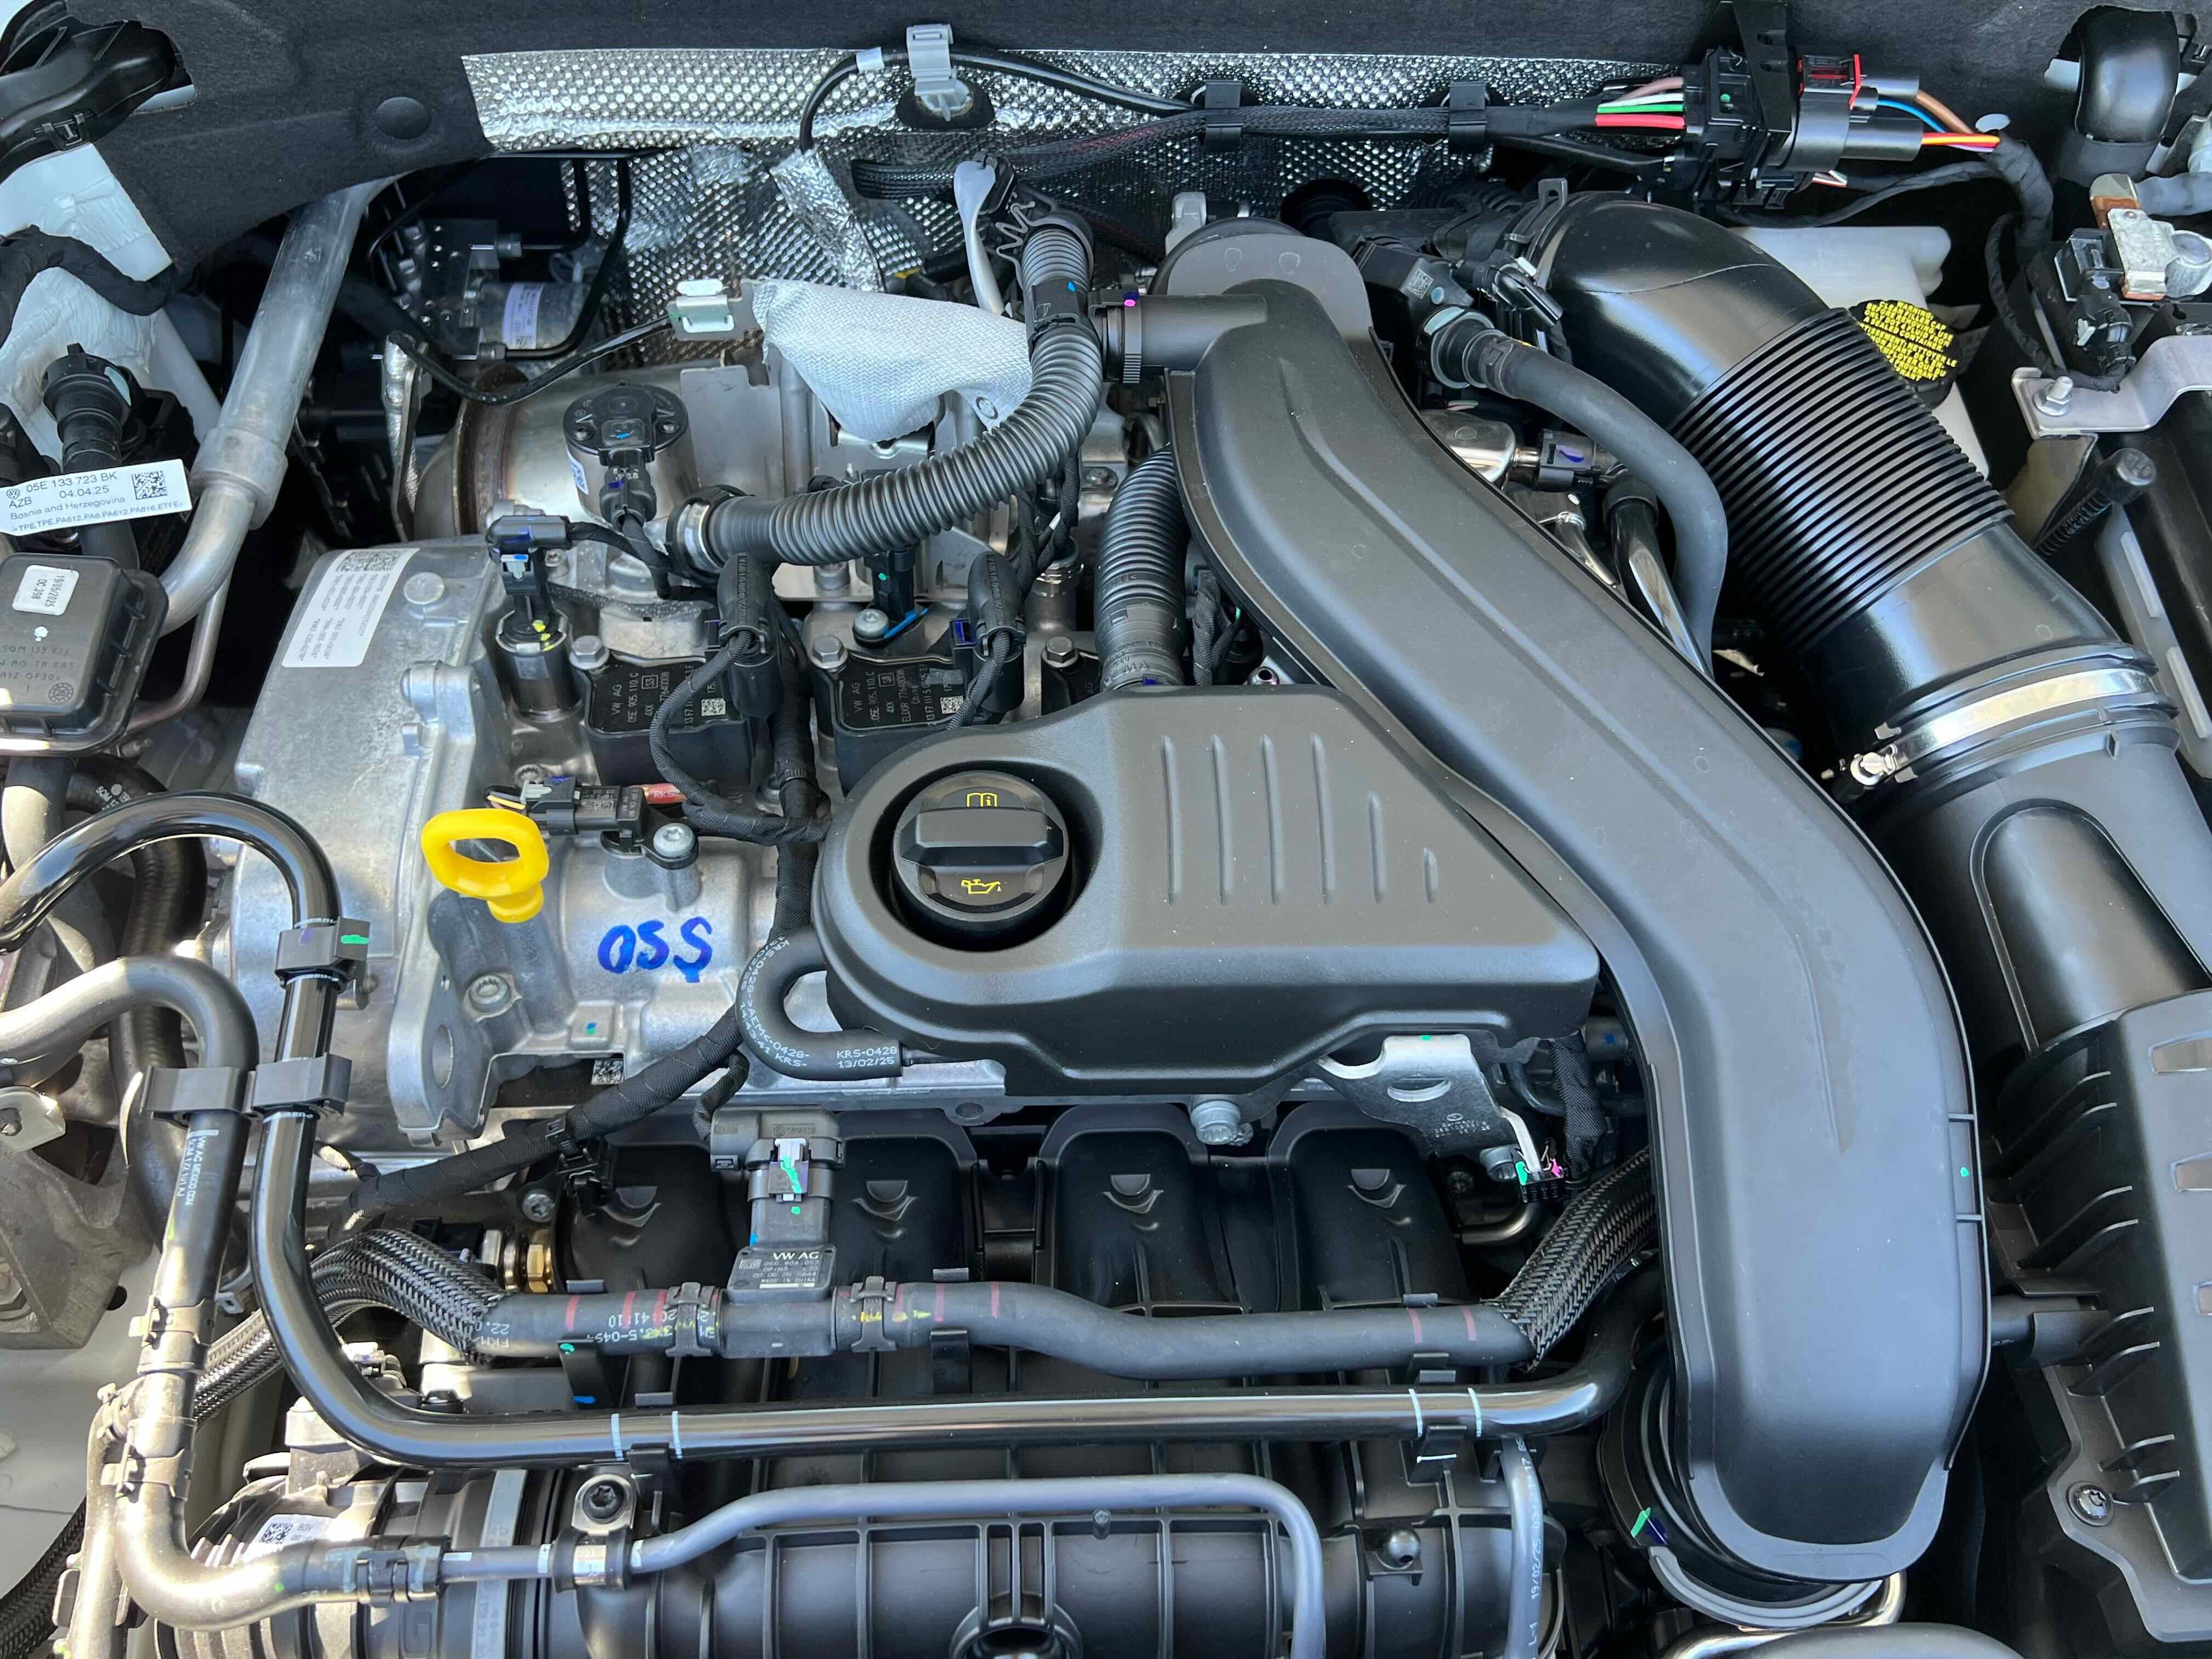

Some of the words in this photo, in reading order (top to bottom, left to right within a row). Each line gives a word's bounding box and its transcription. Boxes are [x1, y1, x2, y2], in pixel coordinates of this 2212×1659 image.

[1866, 302, 1895, 318] BEFORE
[1937, 331, 1953, 342] USE
[1879, 301, 1904, 314] CLEAN
[1904, 311, 1930, 326] FILLER
[1931, 321, 1946, 331] CAP
[1864, 309, 1884, 321] ONLY
[1884, 318, 1899, 326] DOT
[1906, 325, 1928, 338] FLUID
[1928, 335, 1950, 347] FROM
[1870, 318, 1899, 334] SEALED
[1887, 342, 1911, 355] AVANT
[1906, 342, 1945, 362] NETTOYER
[1946, 358, 1957, 367] LE
[1918, 362, 1934, 371] QUE
[1934, 368, 1946, 376] DU
[26, 481, 47, 493] 05E
[53, 476, 73, 488] 133
[77, 475, 97, 486] 723
[101, 471, 117, 482] BK
[59, 485, 110, 499] 04.04.25
[9, 497, 32, 509] AZB
[10, 508, 42, 520] Bosnia
[44, 503, 63, 512] and
[66, 496, 126, 510] Herzegovina
[613, 684, 622, 696] AG
[851, 681, 861, 694] AG
[853, 699, 863, 712] VW
